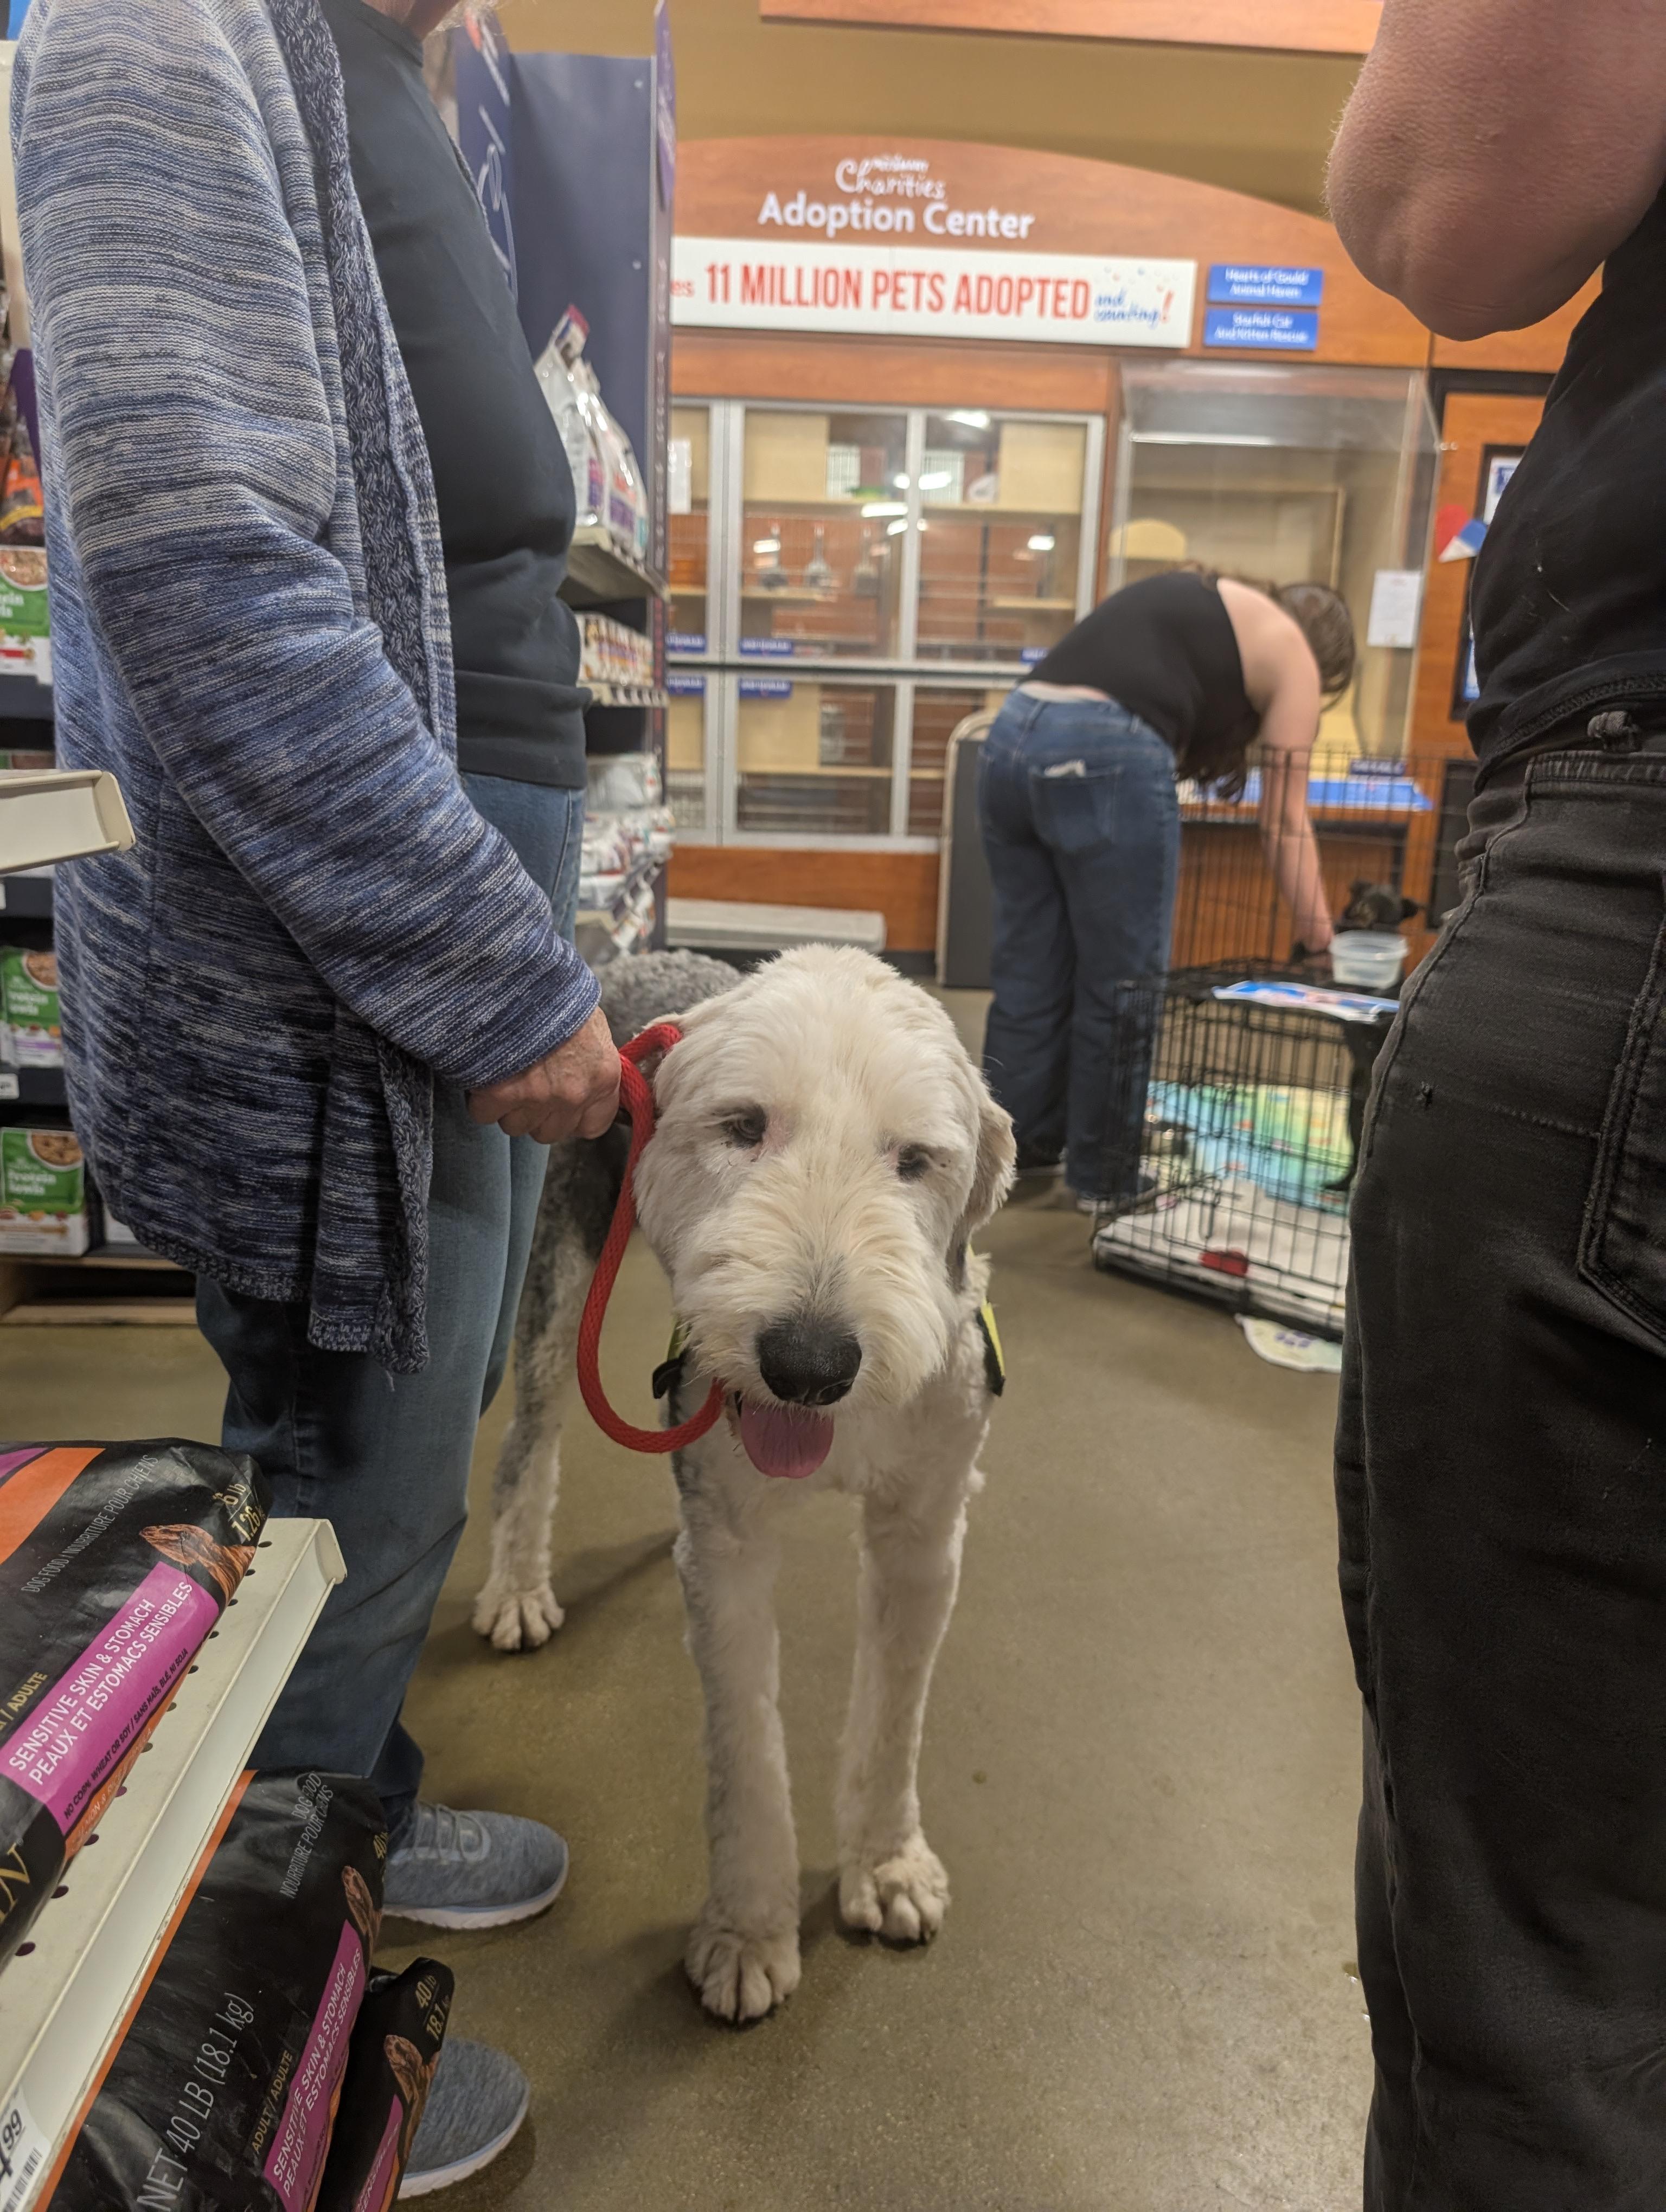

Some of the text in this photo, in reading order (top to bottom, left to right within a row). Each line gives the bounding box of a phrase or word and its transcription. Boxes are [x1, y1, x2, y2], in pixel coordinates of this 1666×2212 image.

[759, 190, 1035, 239] Adoption Center
[706, 264, 730, 303] 11
[741, 265, 861, 308] MILLION
[872, 270, 945, 312] PETS
[953, 273, 1091, 319] ADOPTED
[21, 1577, 50, 1592] DOG
[38, 1559, 69, 1577] FOOD
[62, 1512, 116, 1554] NOURRITURE
[104, 1488, 133, 1515] POUR
[124, 1454, 158, 1490] CHIENS
[7, 1671, 49, 1712] ADULTE
[9, 1598, 156, 1771] SENSITIVE SKIN & STOMACH
[28, 1728, 78, 1785] PEAUX
[70, 1707, 92, 1732] ET
[86, 1640, 148, 1712] ESTOMACS
[139, 1581, 193, 1643] SENSIBLES
[91, 1751, 112, 1780] WHEAT
[112, 1740, 120, 1754] OR
[119, 1722, 131, 1742] SOY
[134, 1701, 148, 1724] SANS
[175, 1648, 188, 1667] SOJA
[279, 1841, 313, 1899] NOURRITURE
[301, 1814, 325, 1846] POUR
[291, 1796, 312, 1820] DOG
[415, 1981, 432, 2008] 40
[137, 1992, 254, 2212] NET 40 LB (18.1 kg)
[252, 2105, 268, 2155] ADULT
[271, 2049, 293, 2101] ADULTE
[273, 1962, 346, 2182] SENSITIVE SKIN & STOMACH
[283, 2136, 305, 2198] PEAUX
[306, 2024, 340, 2112] ESTOMACS
[338, 1948, 361, 2025] SENSIBLES
